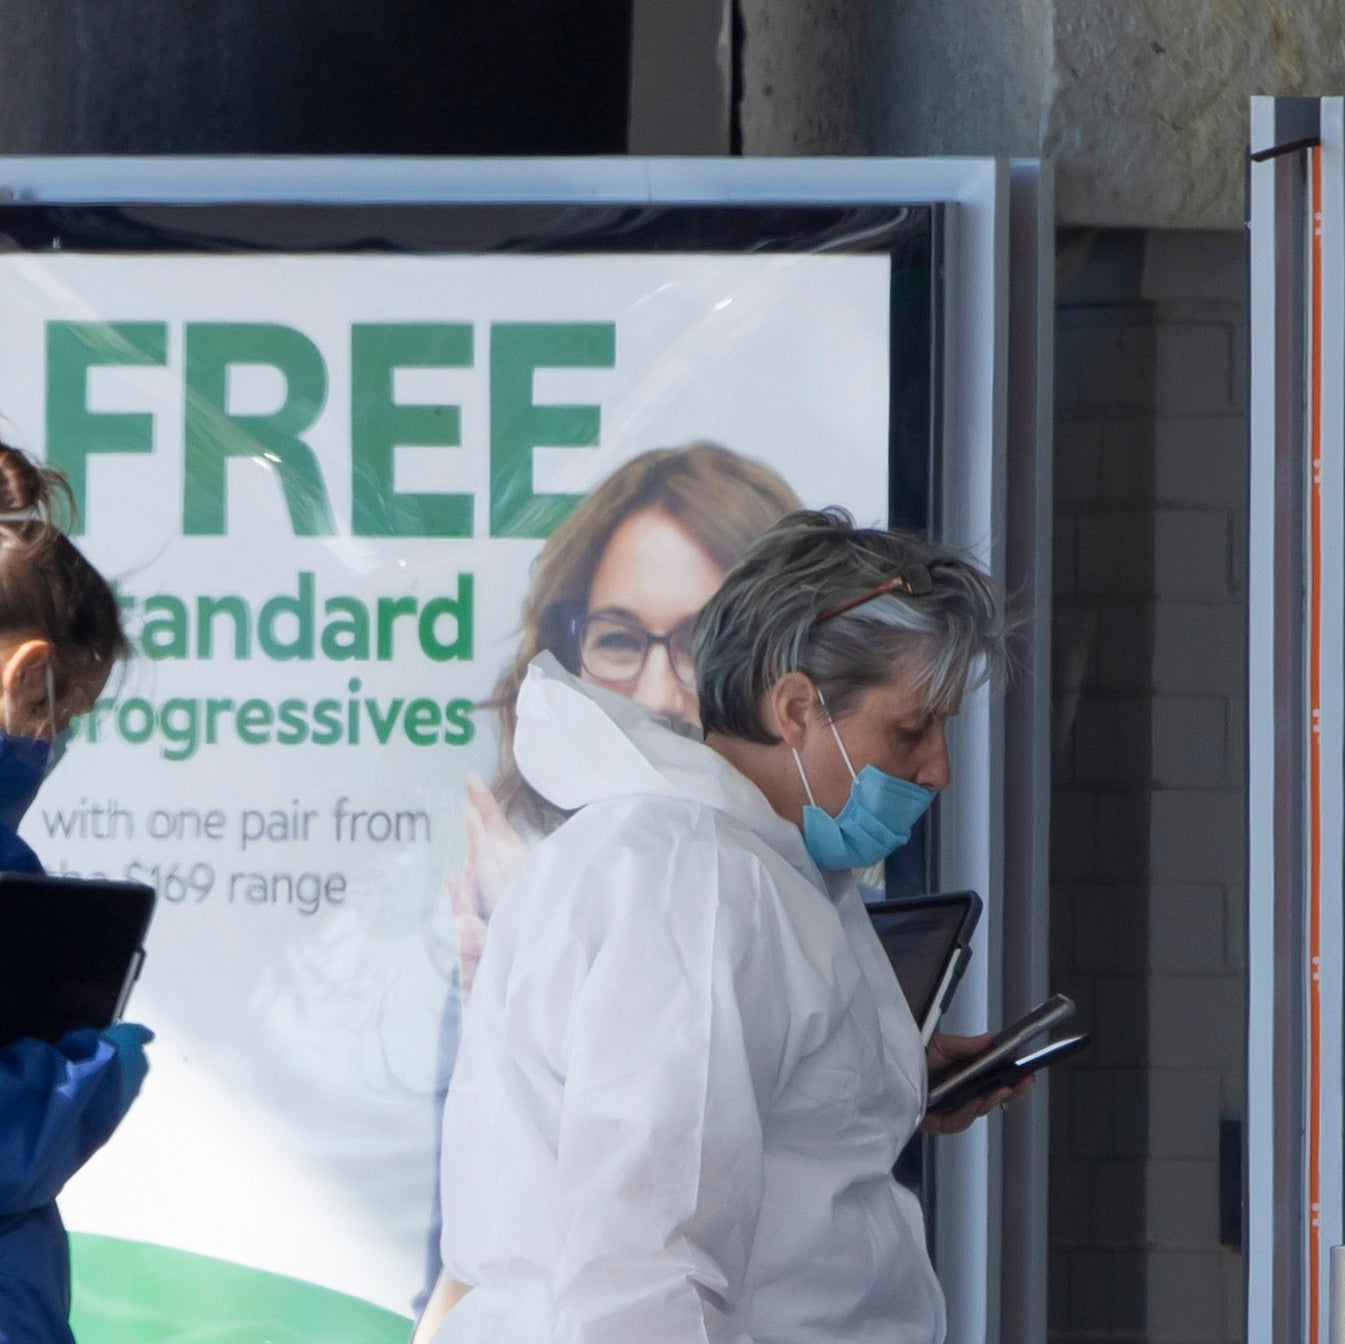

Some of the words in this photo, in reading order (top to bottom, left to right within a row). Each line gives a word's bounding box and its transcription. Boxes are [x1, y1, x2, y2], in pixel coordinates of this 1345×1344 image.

[44, 320, 616, 539] FREE
[110, 571, 474, 662] andard
[70, 678, 476, 762] rogressives
[42, 796, 133, 840] with
[146, 806, 226, 841] one
[241, 798, 319, 851] pair
[334, 796, 432, 843] from
[229, 870, 347, 916] range
